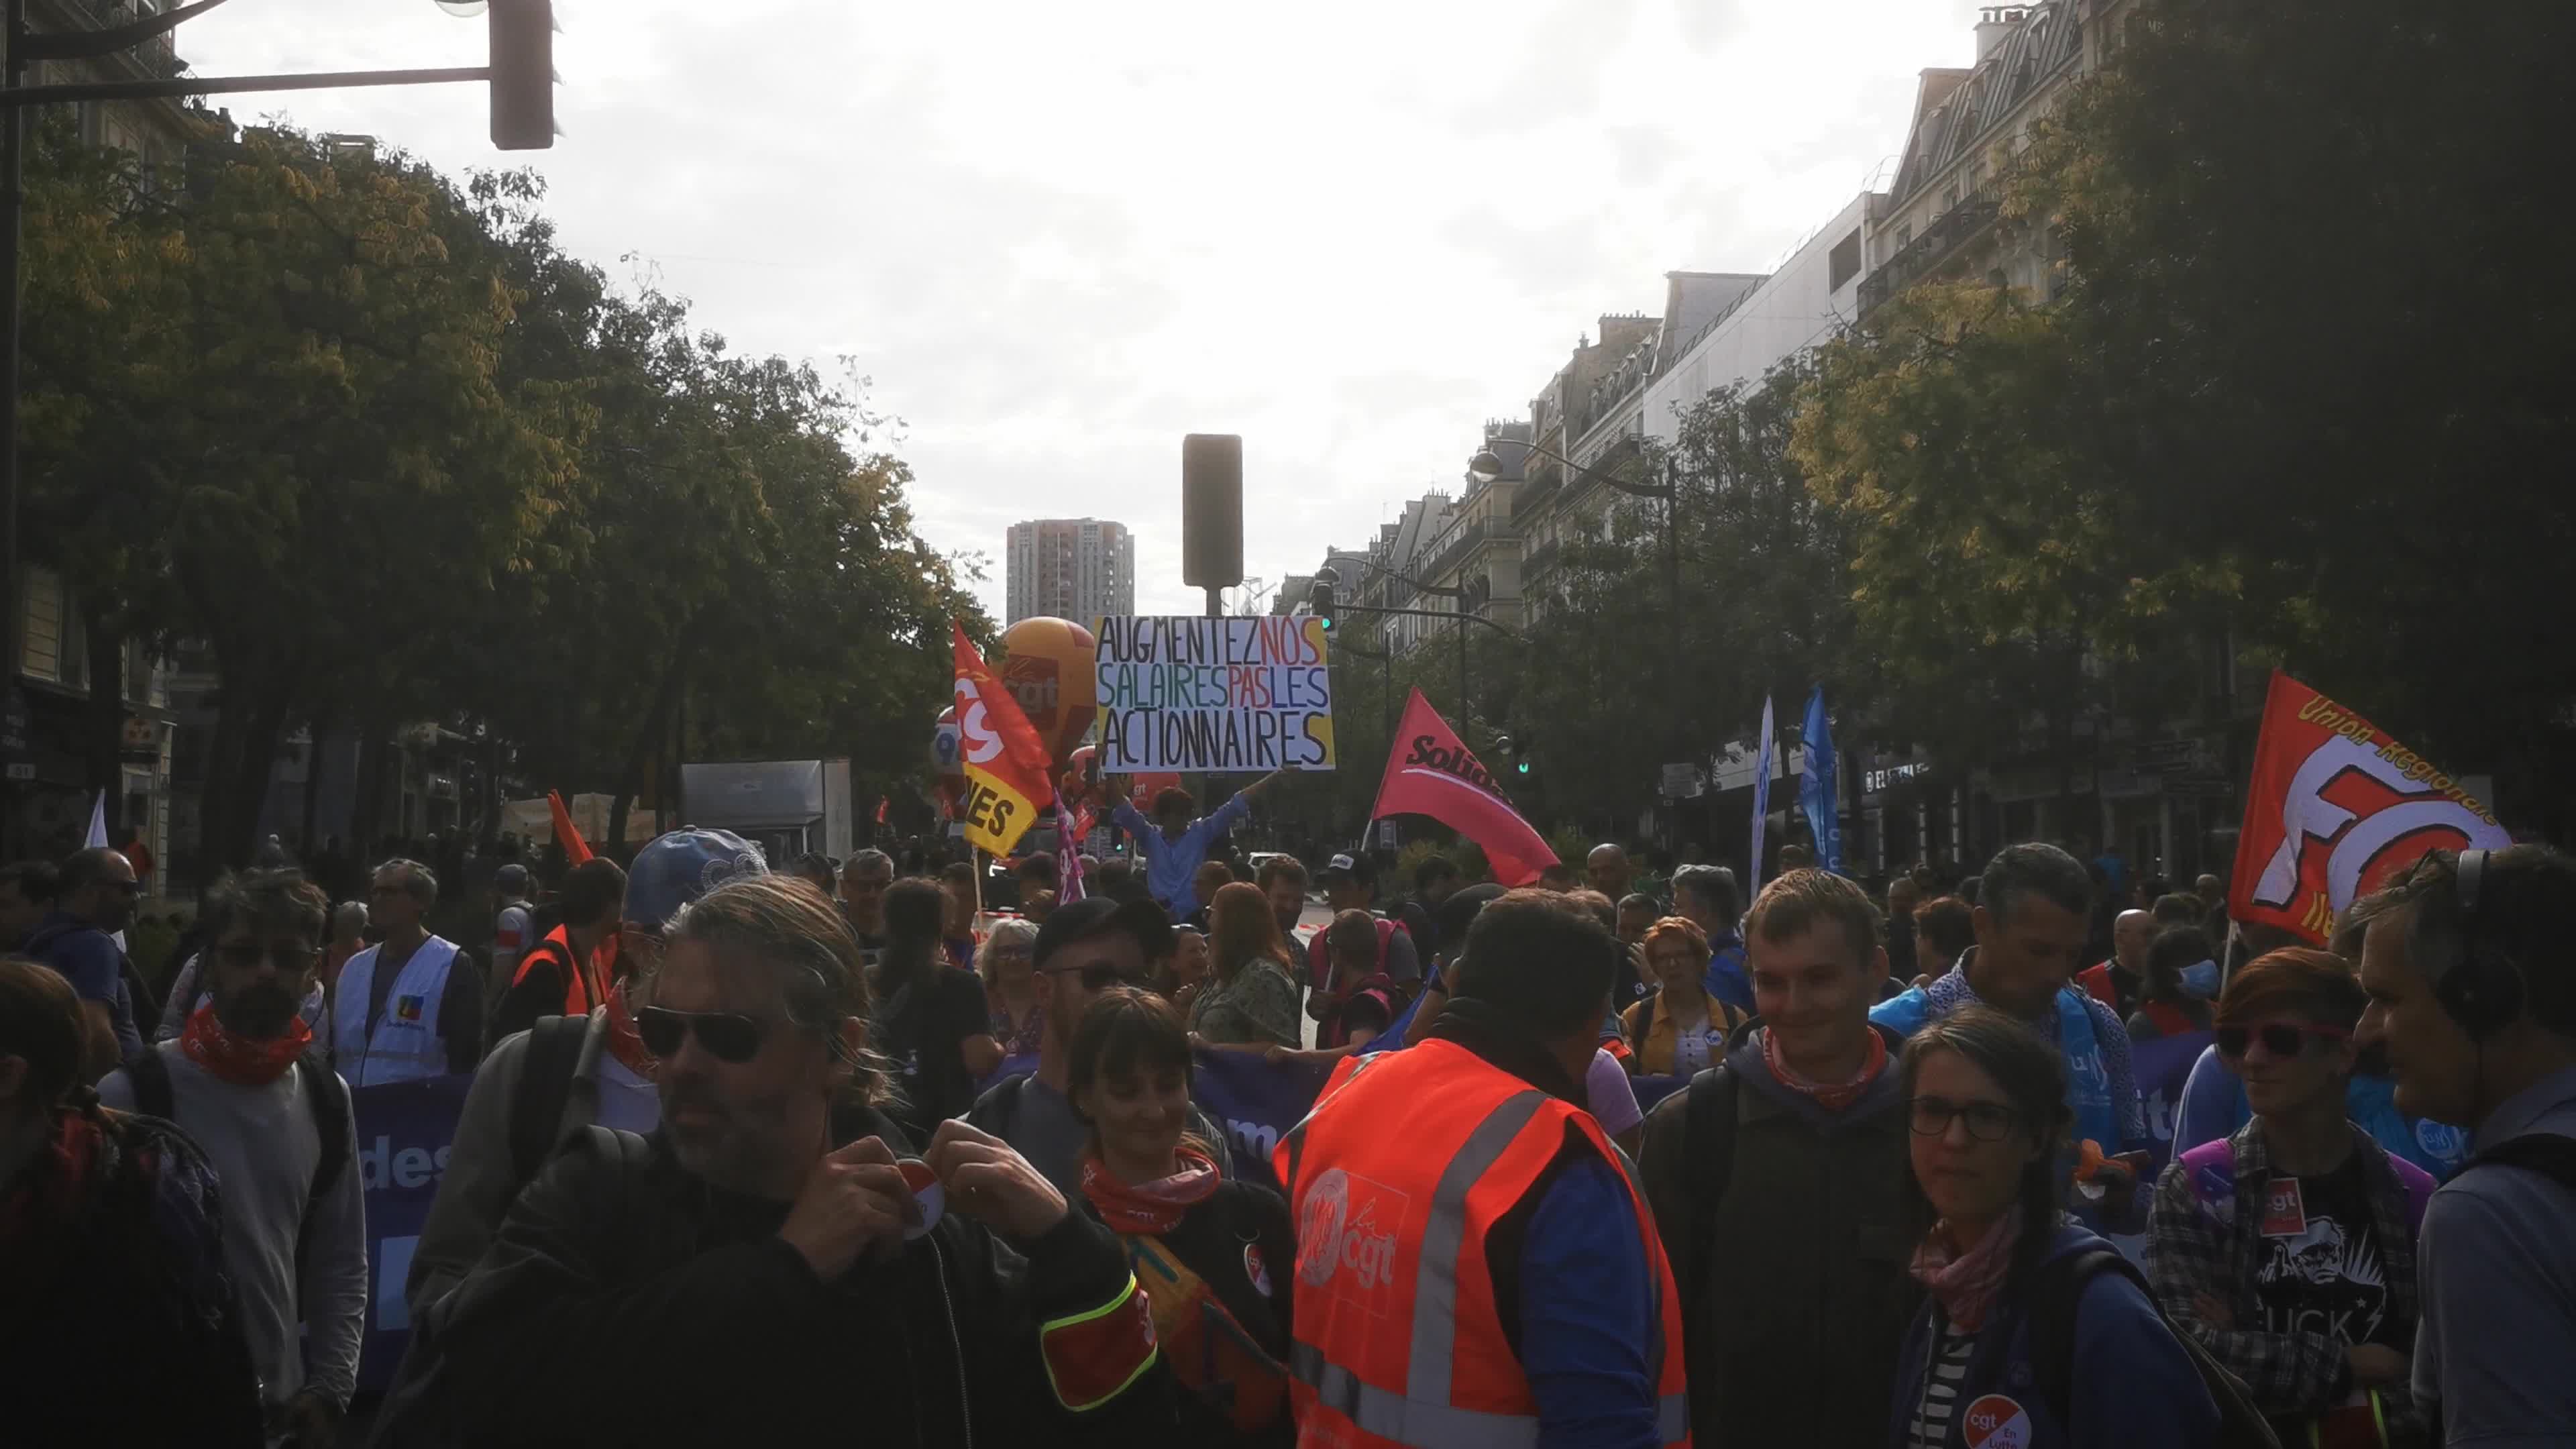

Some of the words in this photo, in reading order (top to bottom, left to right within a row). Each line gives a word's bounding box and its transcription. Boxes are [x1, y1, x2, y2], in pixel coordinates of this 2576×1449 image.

[1095, 615, 1260, 665] AUGMENTEZ
[1260, 616, 1320, 665] NOS
[1098, 663, 1228, 708] SALAIRES
[1228, 665, 1270, 708] PAS
[1269, 666, 1328, 708] LES
[1102, 706, 1327, 768] ACTIONNAIRES
[2298, 695, 2375, 745] Union
[1342, 1229, 1397, 1289] cgt
[1970, 1412, 1997, 1431] cgt
[2004, 1427, 2017, 1439] En
